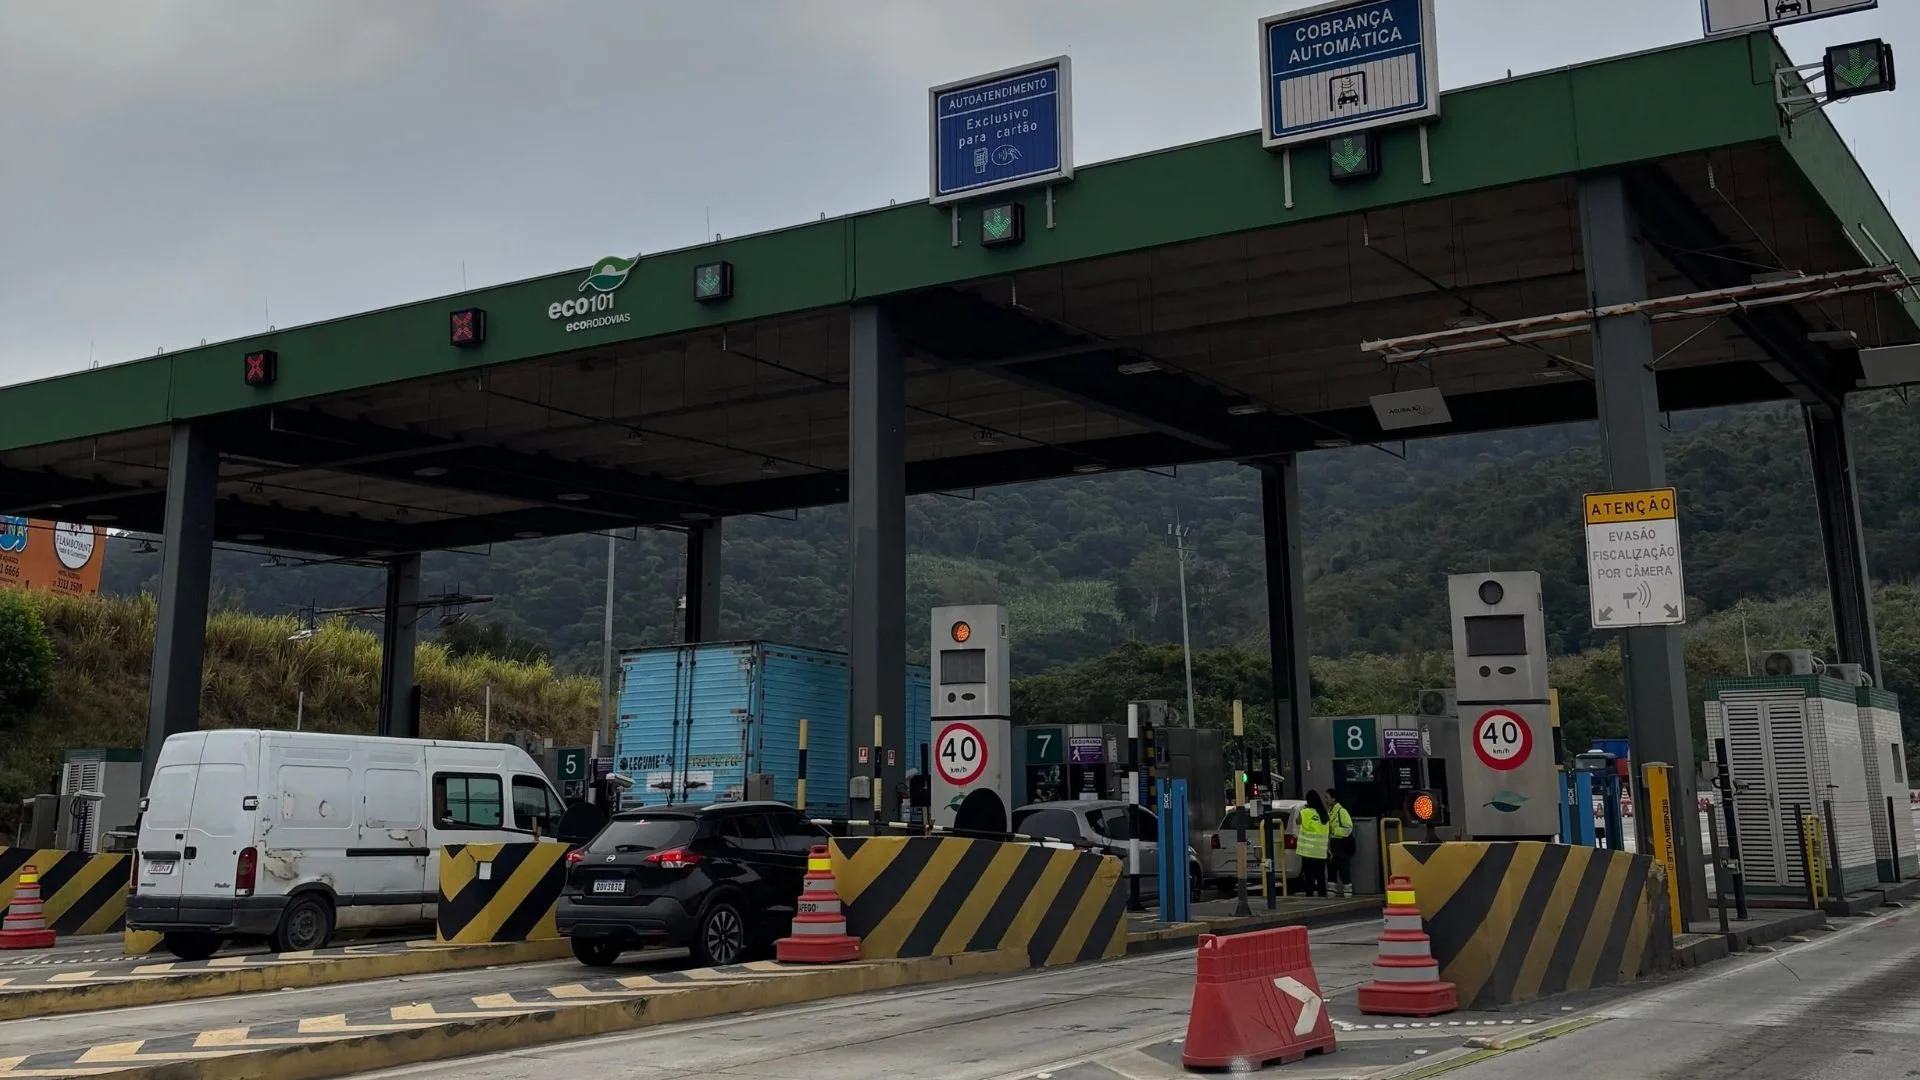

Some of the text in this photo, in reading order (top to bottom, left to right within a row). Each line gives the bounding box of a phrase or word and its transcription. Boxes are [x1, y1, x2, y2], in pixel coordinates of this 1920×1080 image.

[1295, 8, 1394, 42] COBRANÇA
[1288, 26, 1402, 65] AUTOMÁTICA
[948, 77, 1048, 110] AUTOATENDIMENTO
[966, 108, 1029, 130] Exclusivo
[959, 121, 1038, 149] para cartão
[548, 292, 615, 320] eco101
[1591, 495, 1670, 516] ATENÇÃO
[1608, 526, 1656, 542] EVASÃO
[1592, 543, 1675, 561] FISCALIZAÇÃO
[1597, 564, 1673, 580] POR CÂMERA
[1347, 725, 1364, 751] 8
[1482, 721, 1518, 745] 40
[942, 736, 977, 763] 40
[1037, 734, 1052, 758] 7
[565, 754, 577, 775] 5
